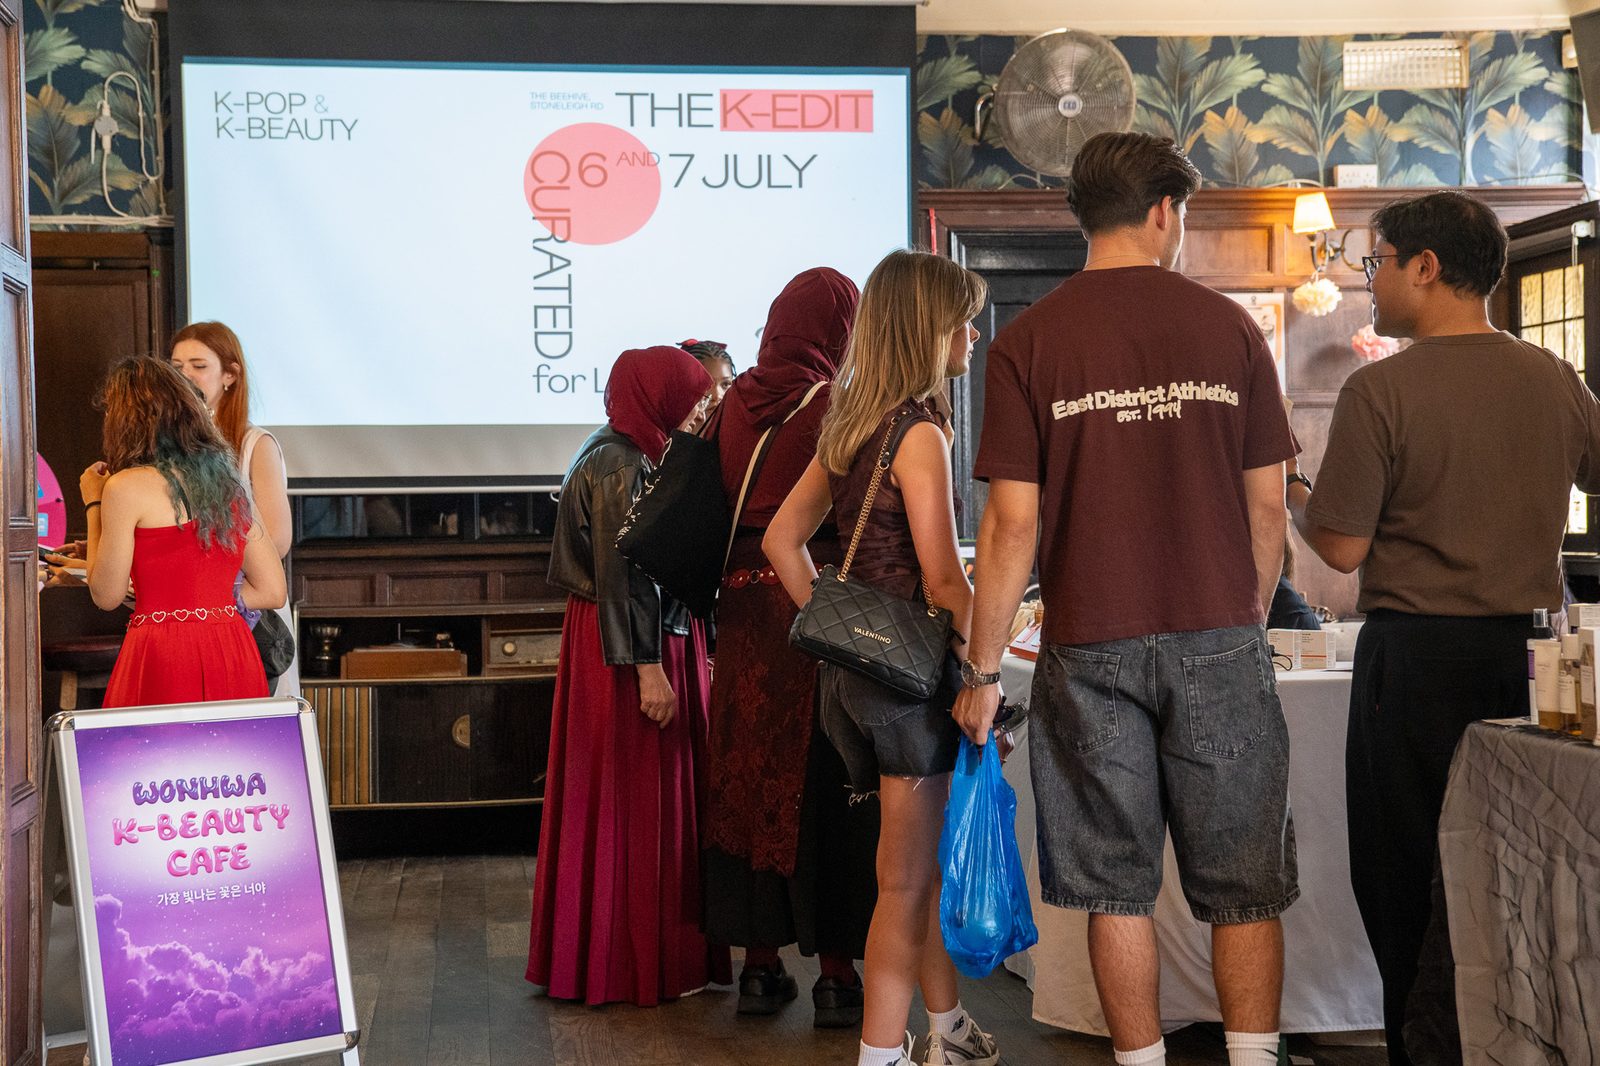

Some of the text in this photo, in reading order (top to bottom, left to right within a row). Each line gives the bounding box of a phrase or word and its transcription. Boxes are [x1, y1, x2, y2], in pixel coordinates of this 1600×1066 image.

[214, 91, 329, 115] K-POP &
[529, 91, 547, 100] THE
[615, 92, 874, 129] THE K-EDIT
[216, 117, 358, 141] K-BEAUTY
[577, 151, 818, 189] 6 AND 7 JULY
[530, 150, 573, 360] CURATED
[532, 364, 586, 394] for
[1052, 381, 1239, 420] East District Athletics
[1147, 400, 1182, 421] 1994
[853, 626, 892, 645] VALENTINO
[132, 772, 267, 805] WONHWA
[112, 803, 291, 846] K-BEAUTY
[166, 843, 251, 877] CAFE
[157, 881, 267, 906] 가장 빛나는 꽃은 너야
